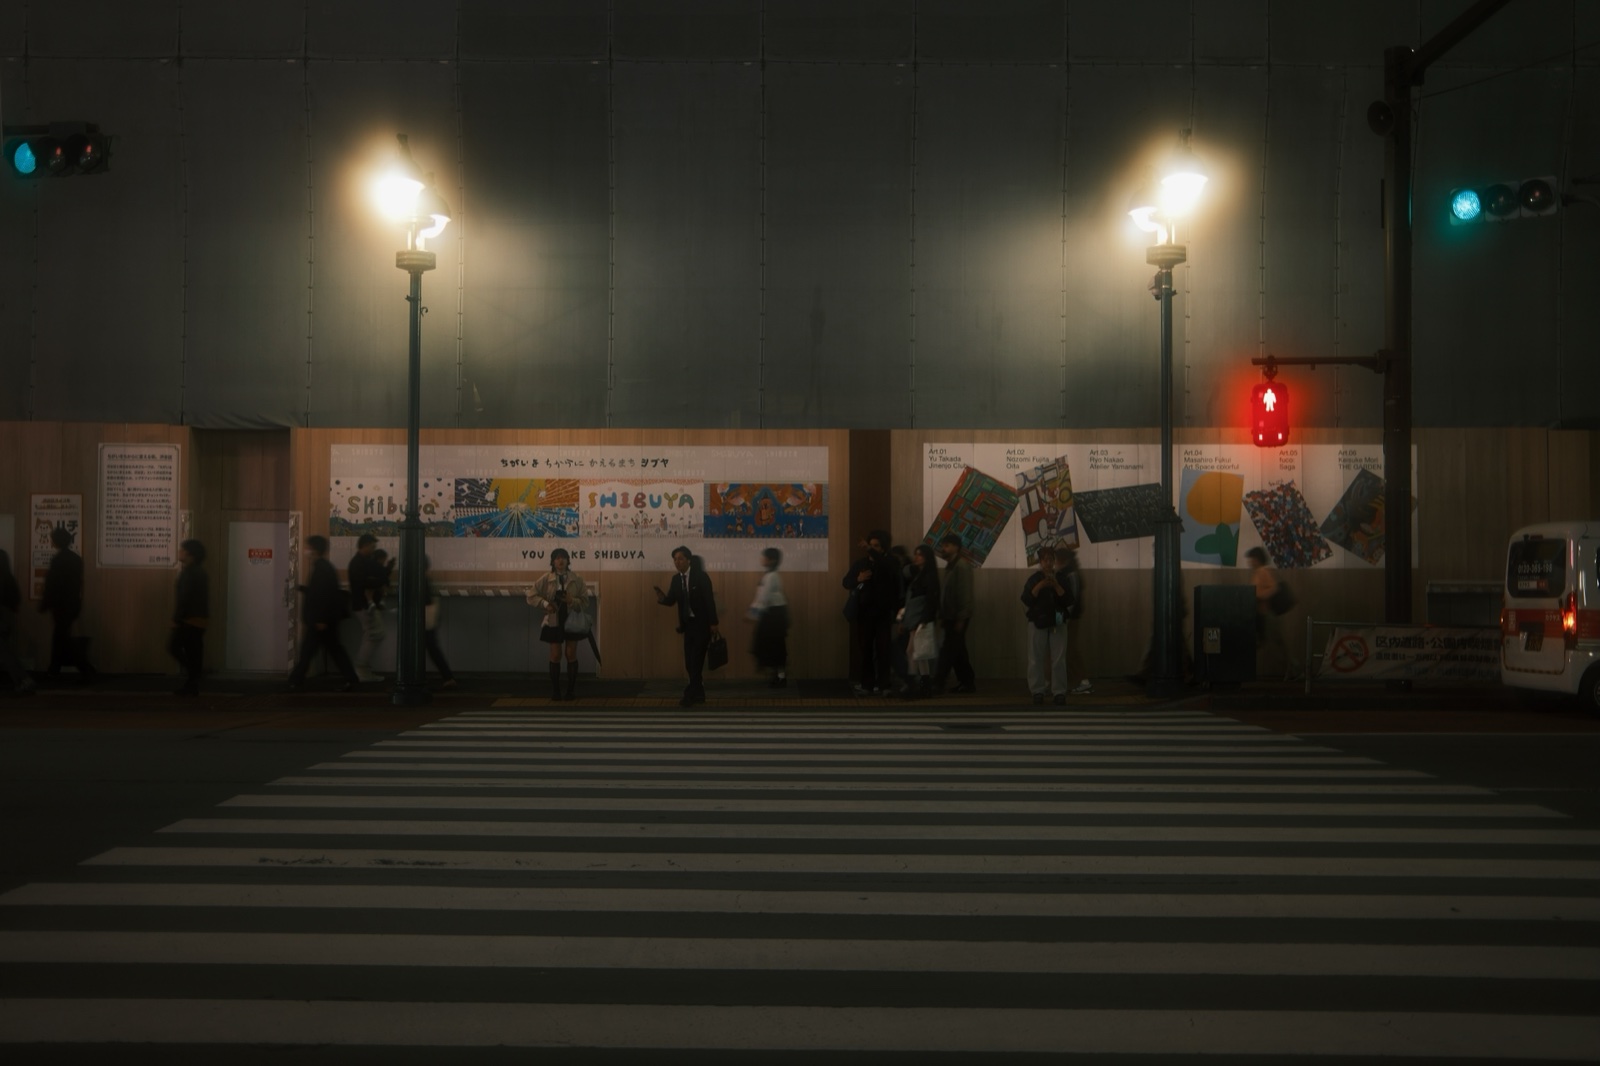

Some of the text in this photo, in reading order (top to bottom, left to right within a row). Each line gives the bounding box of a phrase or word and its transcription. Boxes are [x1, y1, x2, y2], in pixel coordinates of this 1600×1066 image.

[640, 458, 669, 468] シブヤ
[1032, 456, 1050, 464] Fujita
[346, 496, 435, 515] Shibua
[588, 491, 695, 510] SHIBUYA
[521, 550, 545, 559] YOU
[594, 550, 645, 559] SHIBUYA
